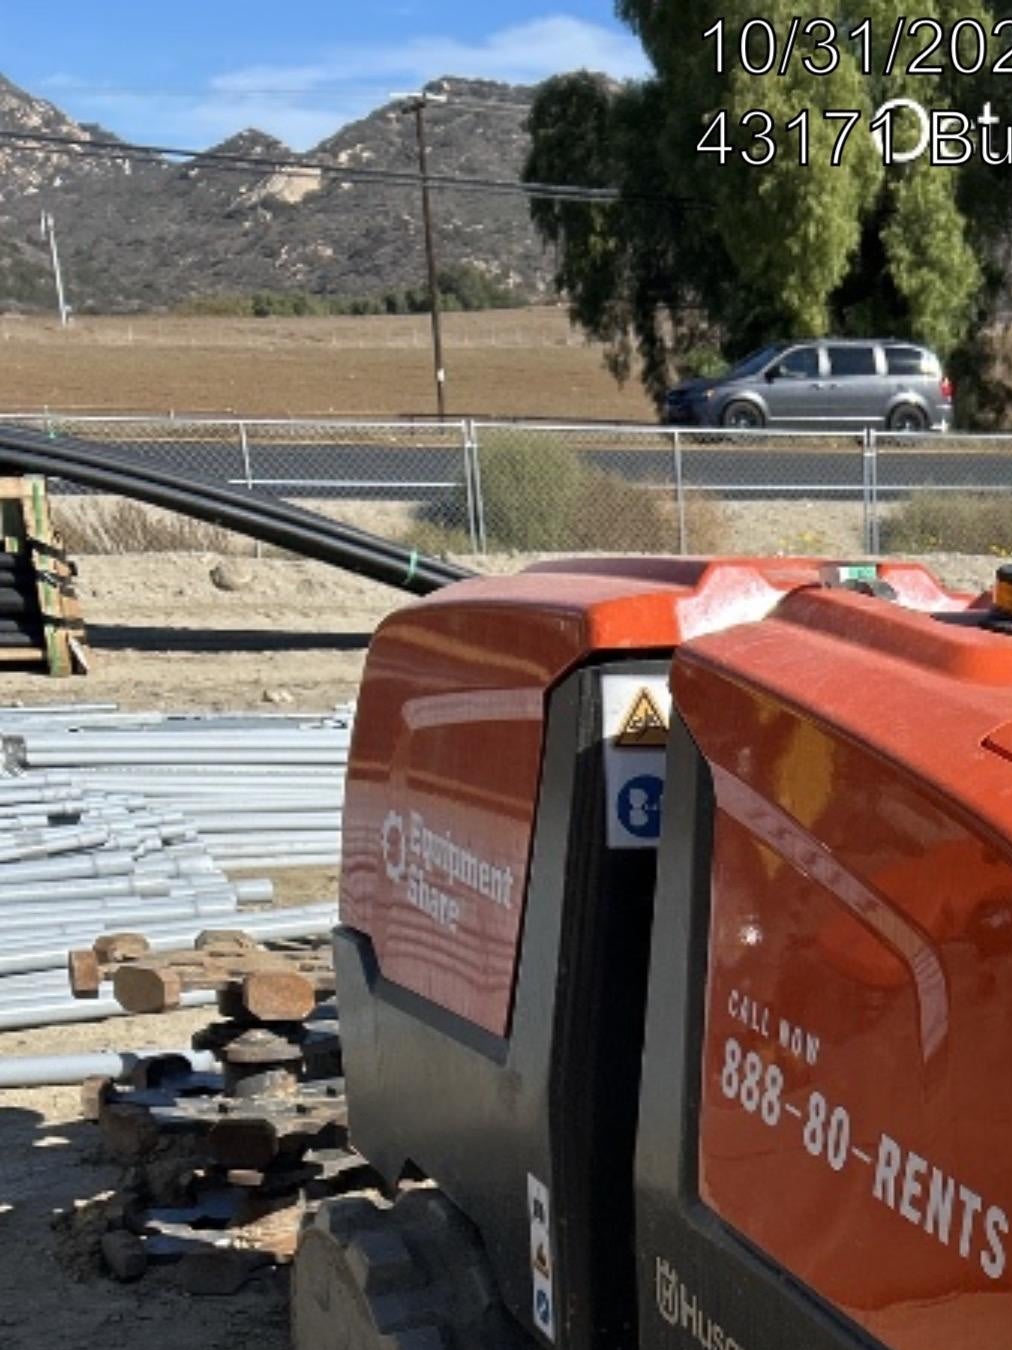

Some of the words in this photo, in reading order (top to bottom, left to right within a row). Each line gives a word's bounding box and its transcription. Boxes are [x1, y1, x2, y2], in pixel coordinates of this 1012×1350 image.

[409, 809, 513, 910] Equipment
[727, 989, 770, 1037] CALL
[778, 1019, 820, 1065] NOW
[721, 1036, 1009, 1279] 888-80-RENTS
